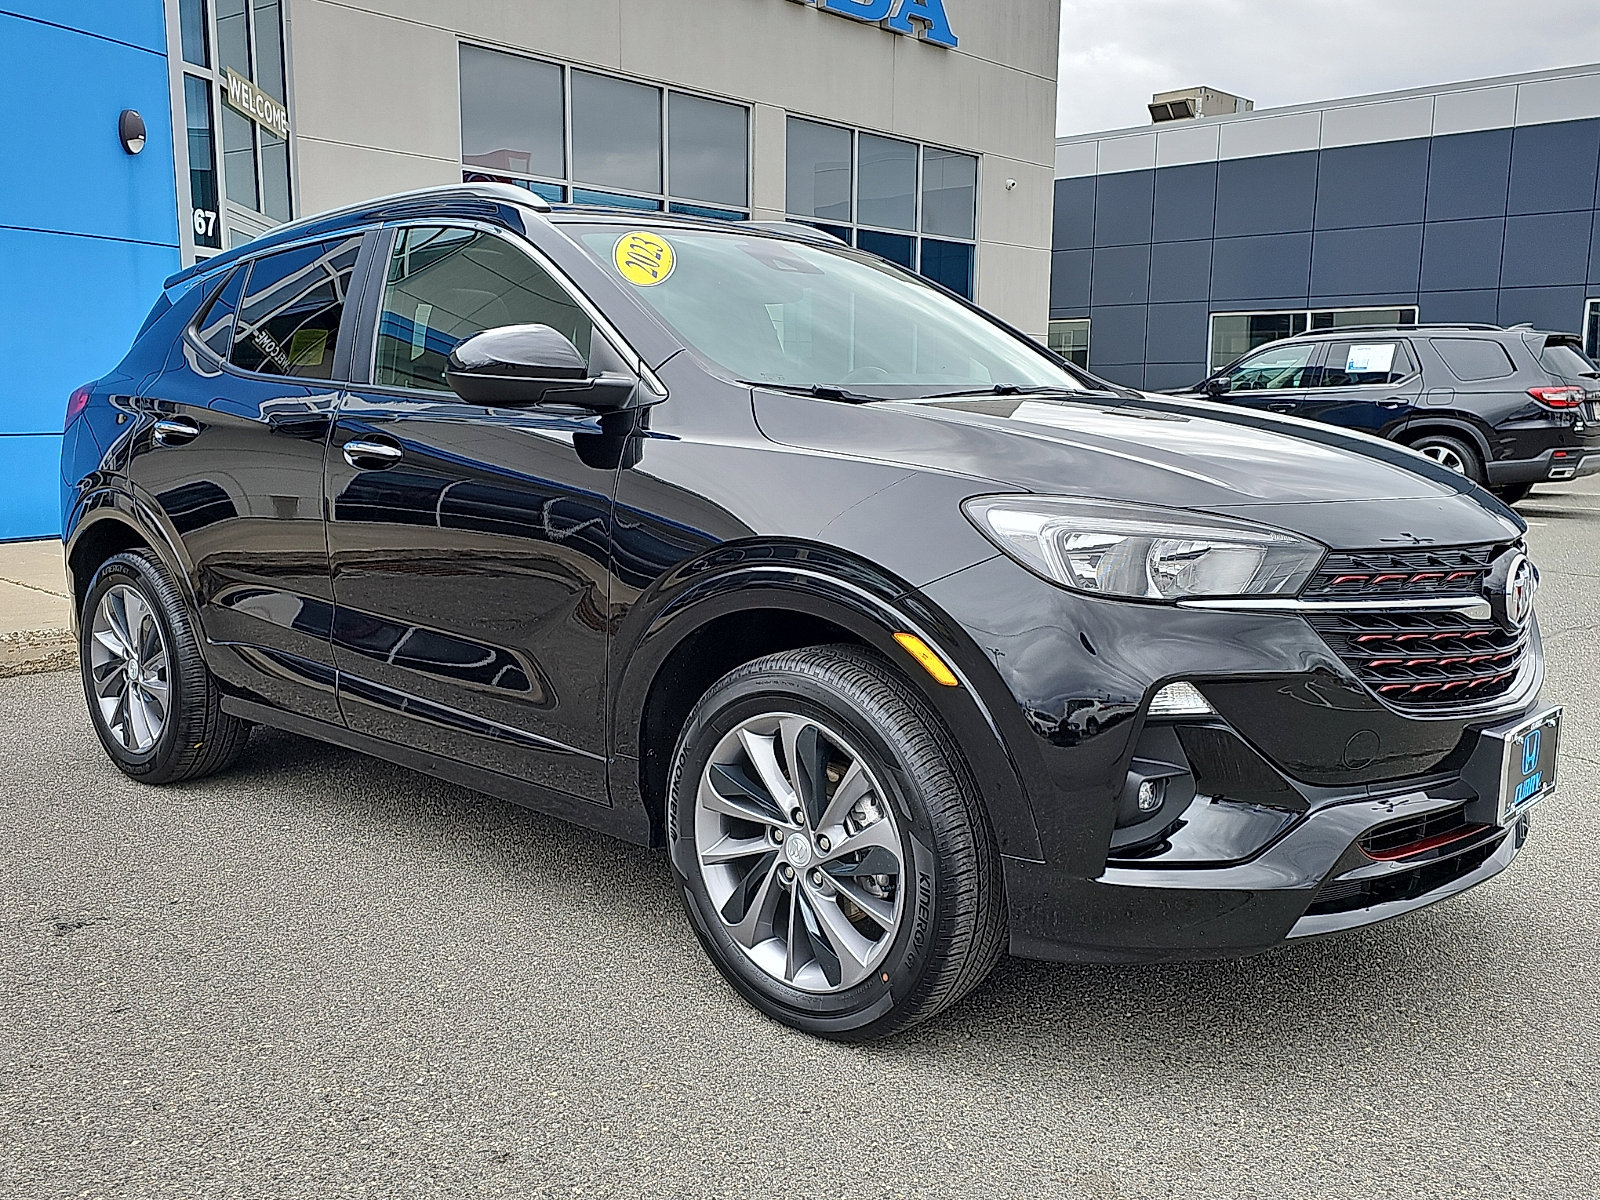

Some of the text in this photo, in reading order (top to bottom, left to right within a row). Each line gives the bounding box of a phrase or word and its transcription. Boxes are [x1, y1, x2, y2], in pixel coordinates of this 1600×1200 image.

[227, 72, 287, 134] WELCOME
[193, 208, 217, 237] 67
[625, 236, 664, 279] 2023
[912, 871, 932, 955] KINERGY
